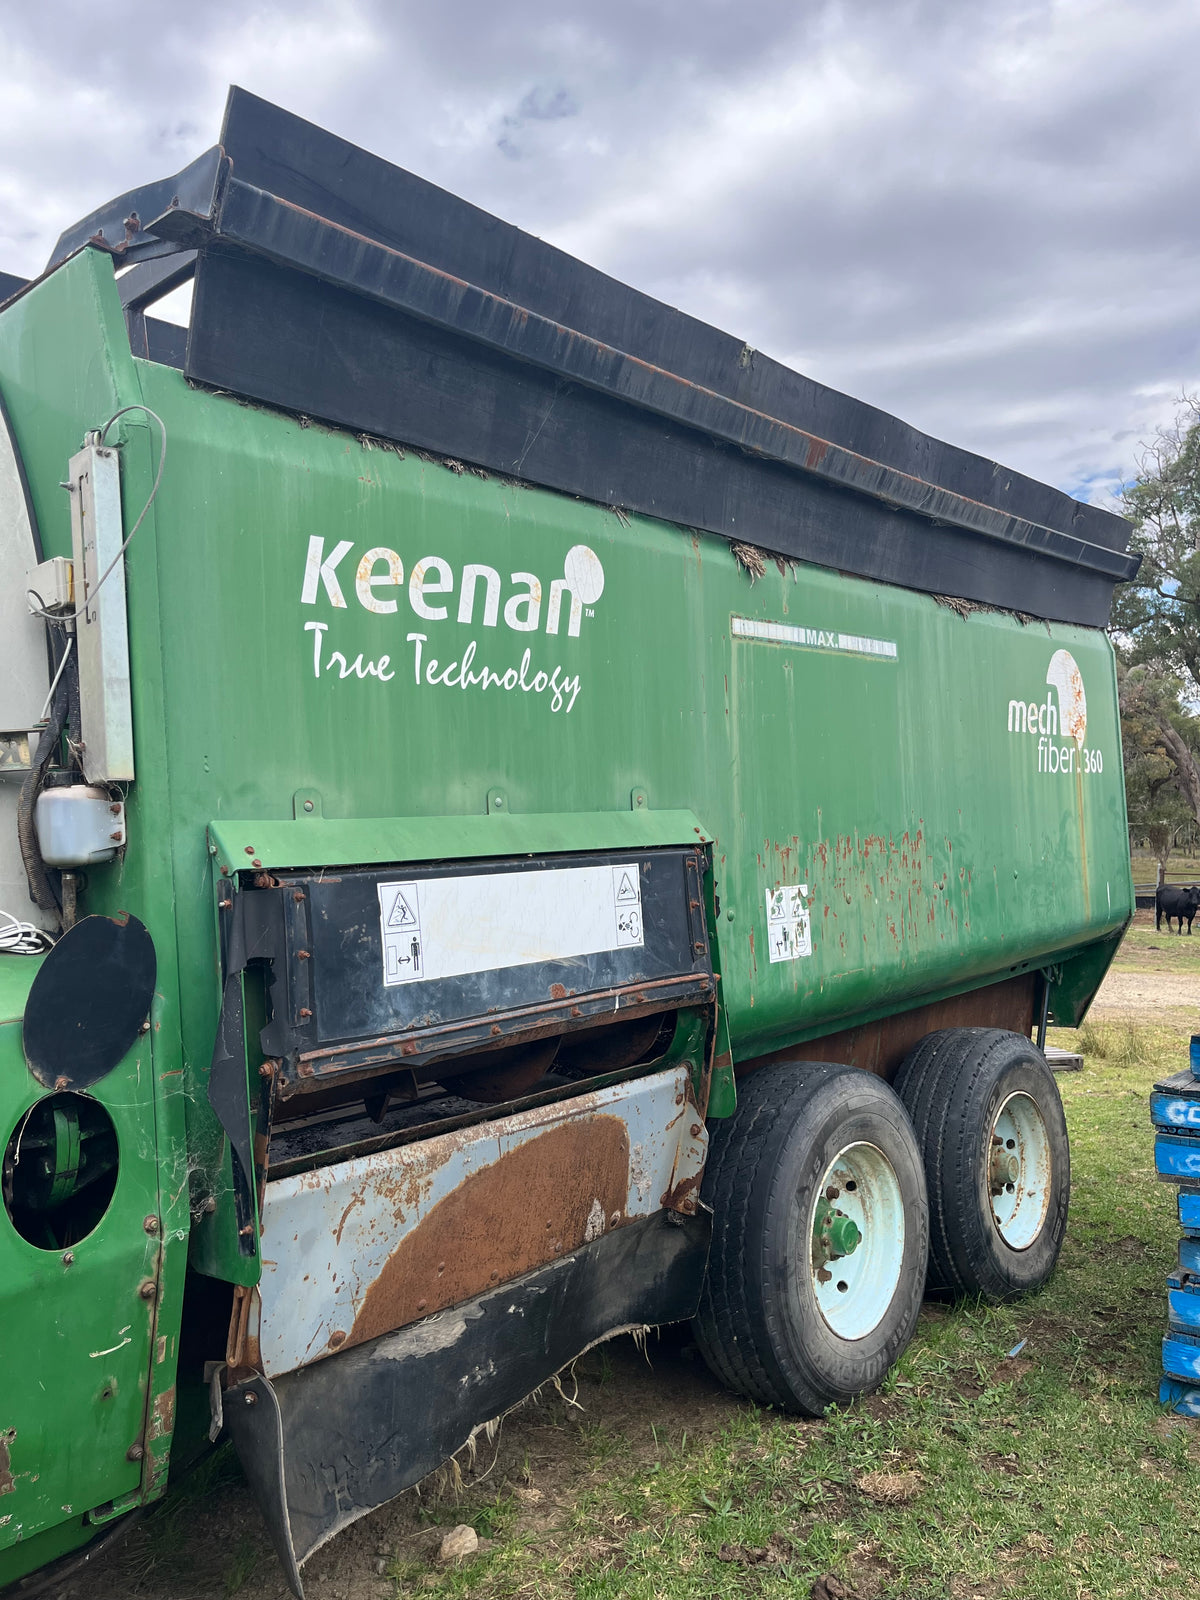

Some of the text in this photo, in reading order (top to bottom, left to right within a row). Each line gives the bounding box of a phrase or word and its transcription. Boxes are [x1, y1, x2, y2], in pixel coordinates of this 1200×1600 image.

[301, 535, 583, 637] Keenan
[304, 621, 582, 713] True Technology
[806, 628, 839, 648] MAX.
[1007, 691, 1058, 736] mech
